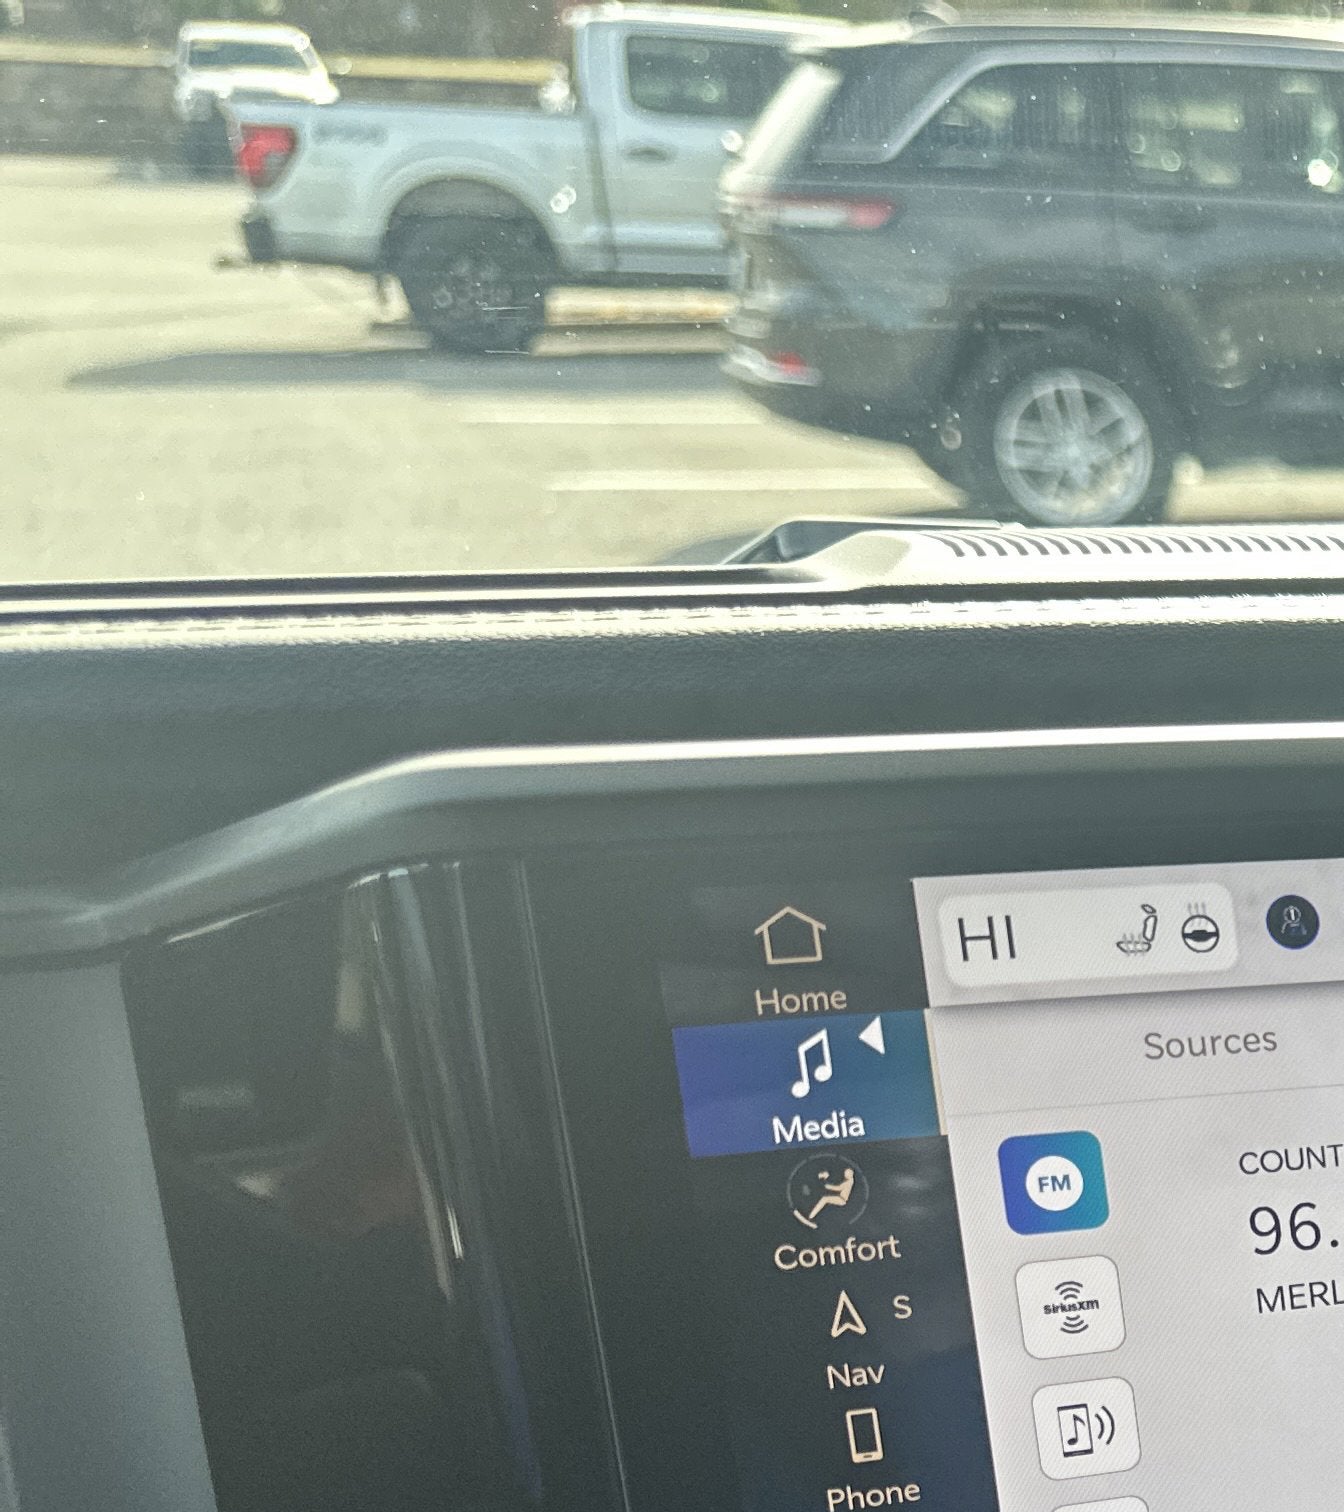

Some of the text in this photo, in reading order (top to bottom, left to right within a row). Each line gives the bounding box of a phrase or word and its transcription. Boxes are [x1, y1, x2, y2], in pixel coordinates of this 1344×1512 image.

[957, 914, 1017, 963] HI
[755, 987, 848, 1016] Home
[1143, 1029, 1278, 1061] Sources
[773, 1112, 866, 1144] Media
[1037, 1174, 1072, 1194] FM
[774, 1234, 901, 1271] Comfort
[892, 1294, 912, 1319] S
[826, 1363, 885, 1390] Nav
